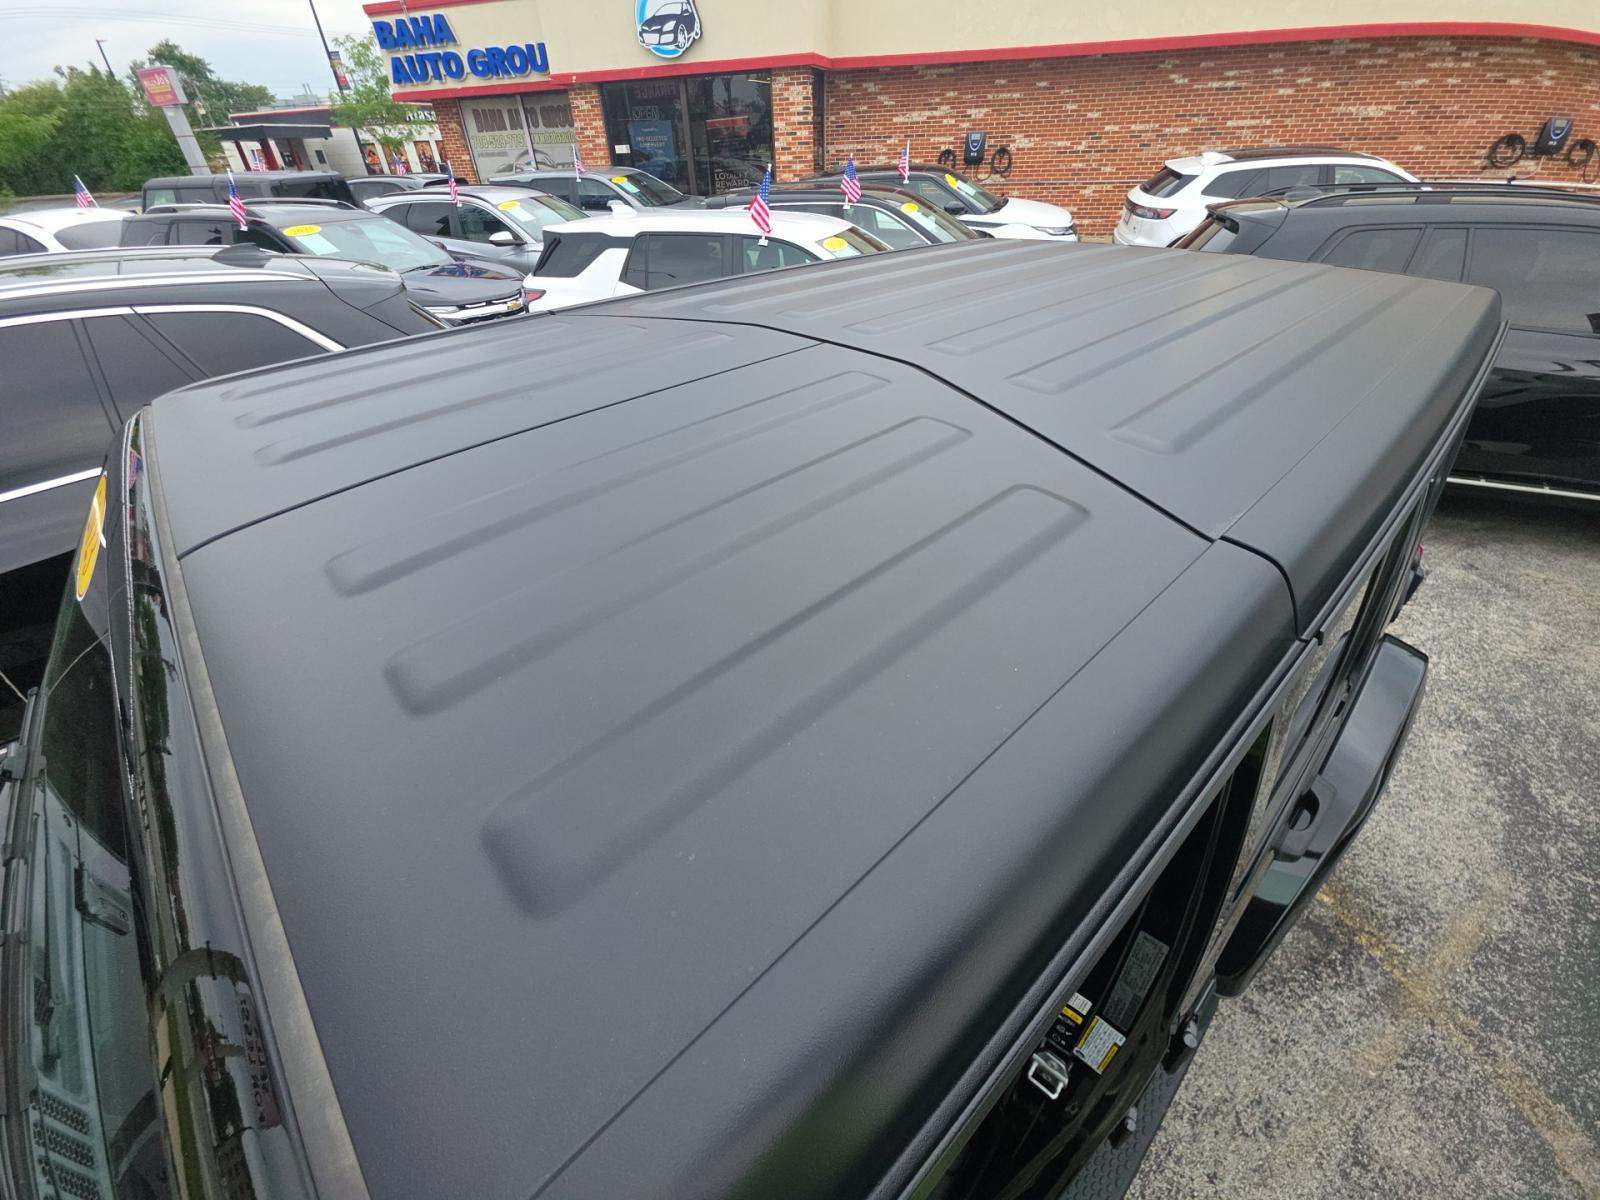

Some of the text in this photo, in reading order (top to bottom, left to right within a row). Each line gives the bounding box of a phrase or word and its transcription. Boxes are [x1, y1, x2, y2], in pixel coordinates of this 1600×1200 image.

[373, 13, 459, 50] BAHA
[391, 42, 550, 84] AUTO GROU
[714, 171, 749, 181] LOYALTY
[715, 179, 750, 189] REWARD
